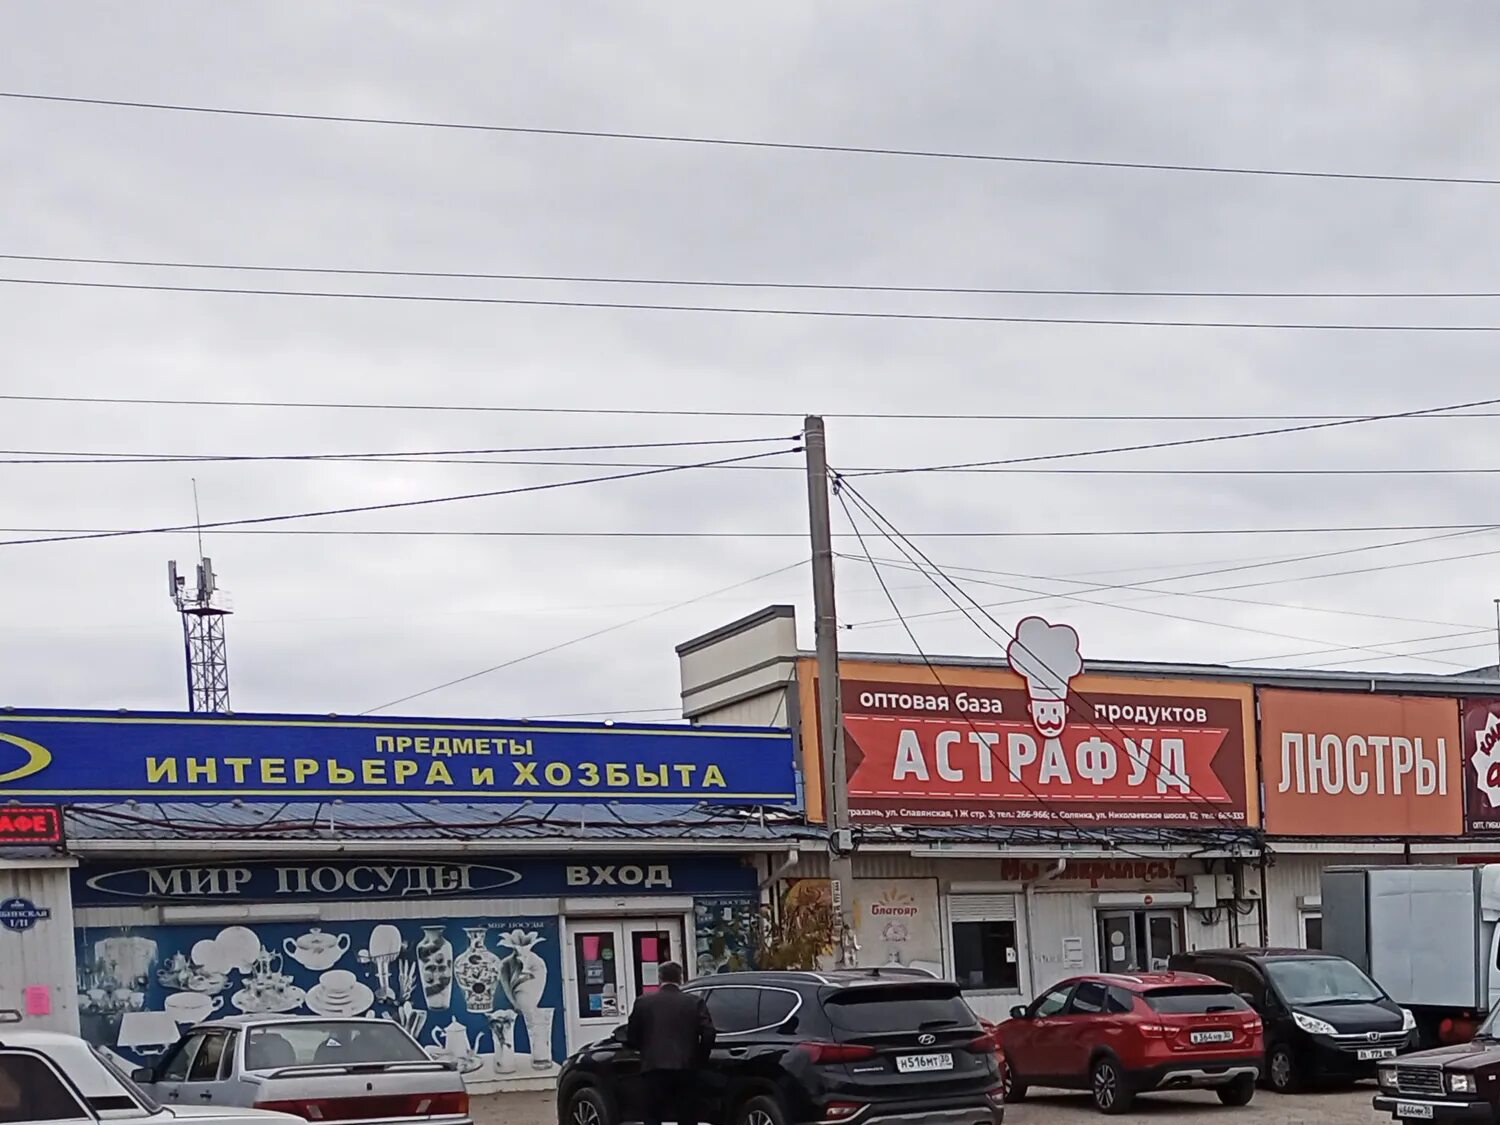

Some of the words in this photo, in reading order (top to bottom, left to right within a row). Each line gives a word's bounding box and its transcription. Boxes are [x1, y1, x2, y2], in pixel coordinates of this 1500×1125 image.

[859, 692, 950, 712] оптовая
[954, 692, 1003, 715] база
[1094, 702, 1207, 725] продуктов
[375, 736, 534, 757] ПРЕДМЕТЫ
[145, 756, 455, 787] ИНТЕРЬЕРА
[471, 768, 495, 785] и
[512, 762, 728, 788] ХОЗБЫТА
[892, 730, 1191, 794] АСТРАФУД
[1278, 732, 1447, 795] ЛЮСТРЫ
[900, 808, 953, 818] Славянская,
[970, 811, 987, 819] стр.
[1060, 811, 1094, 820] Солянка,
[1108, 811, 1162, 820] Николаевское
[147, 867, 252, 894] МИР
[276, 866, 471, 895] ПОСУДЫ
[566, 866, 672, 888] ВХОД
[872, 904, 918, 918] Благояр
